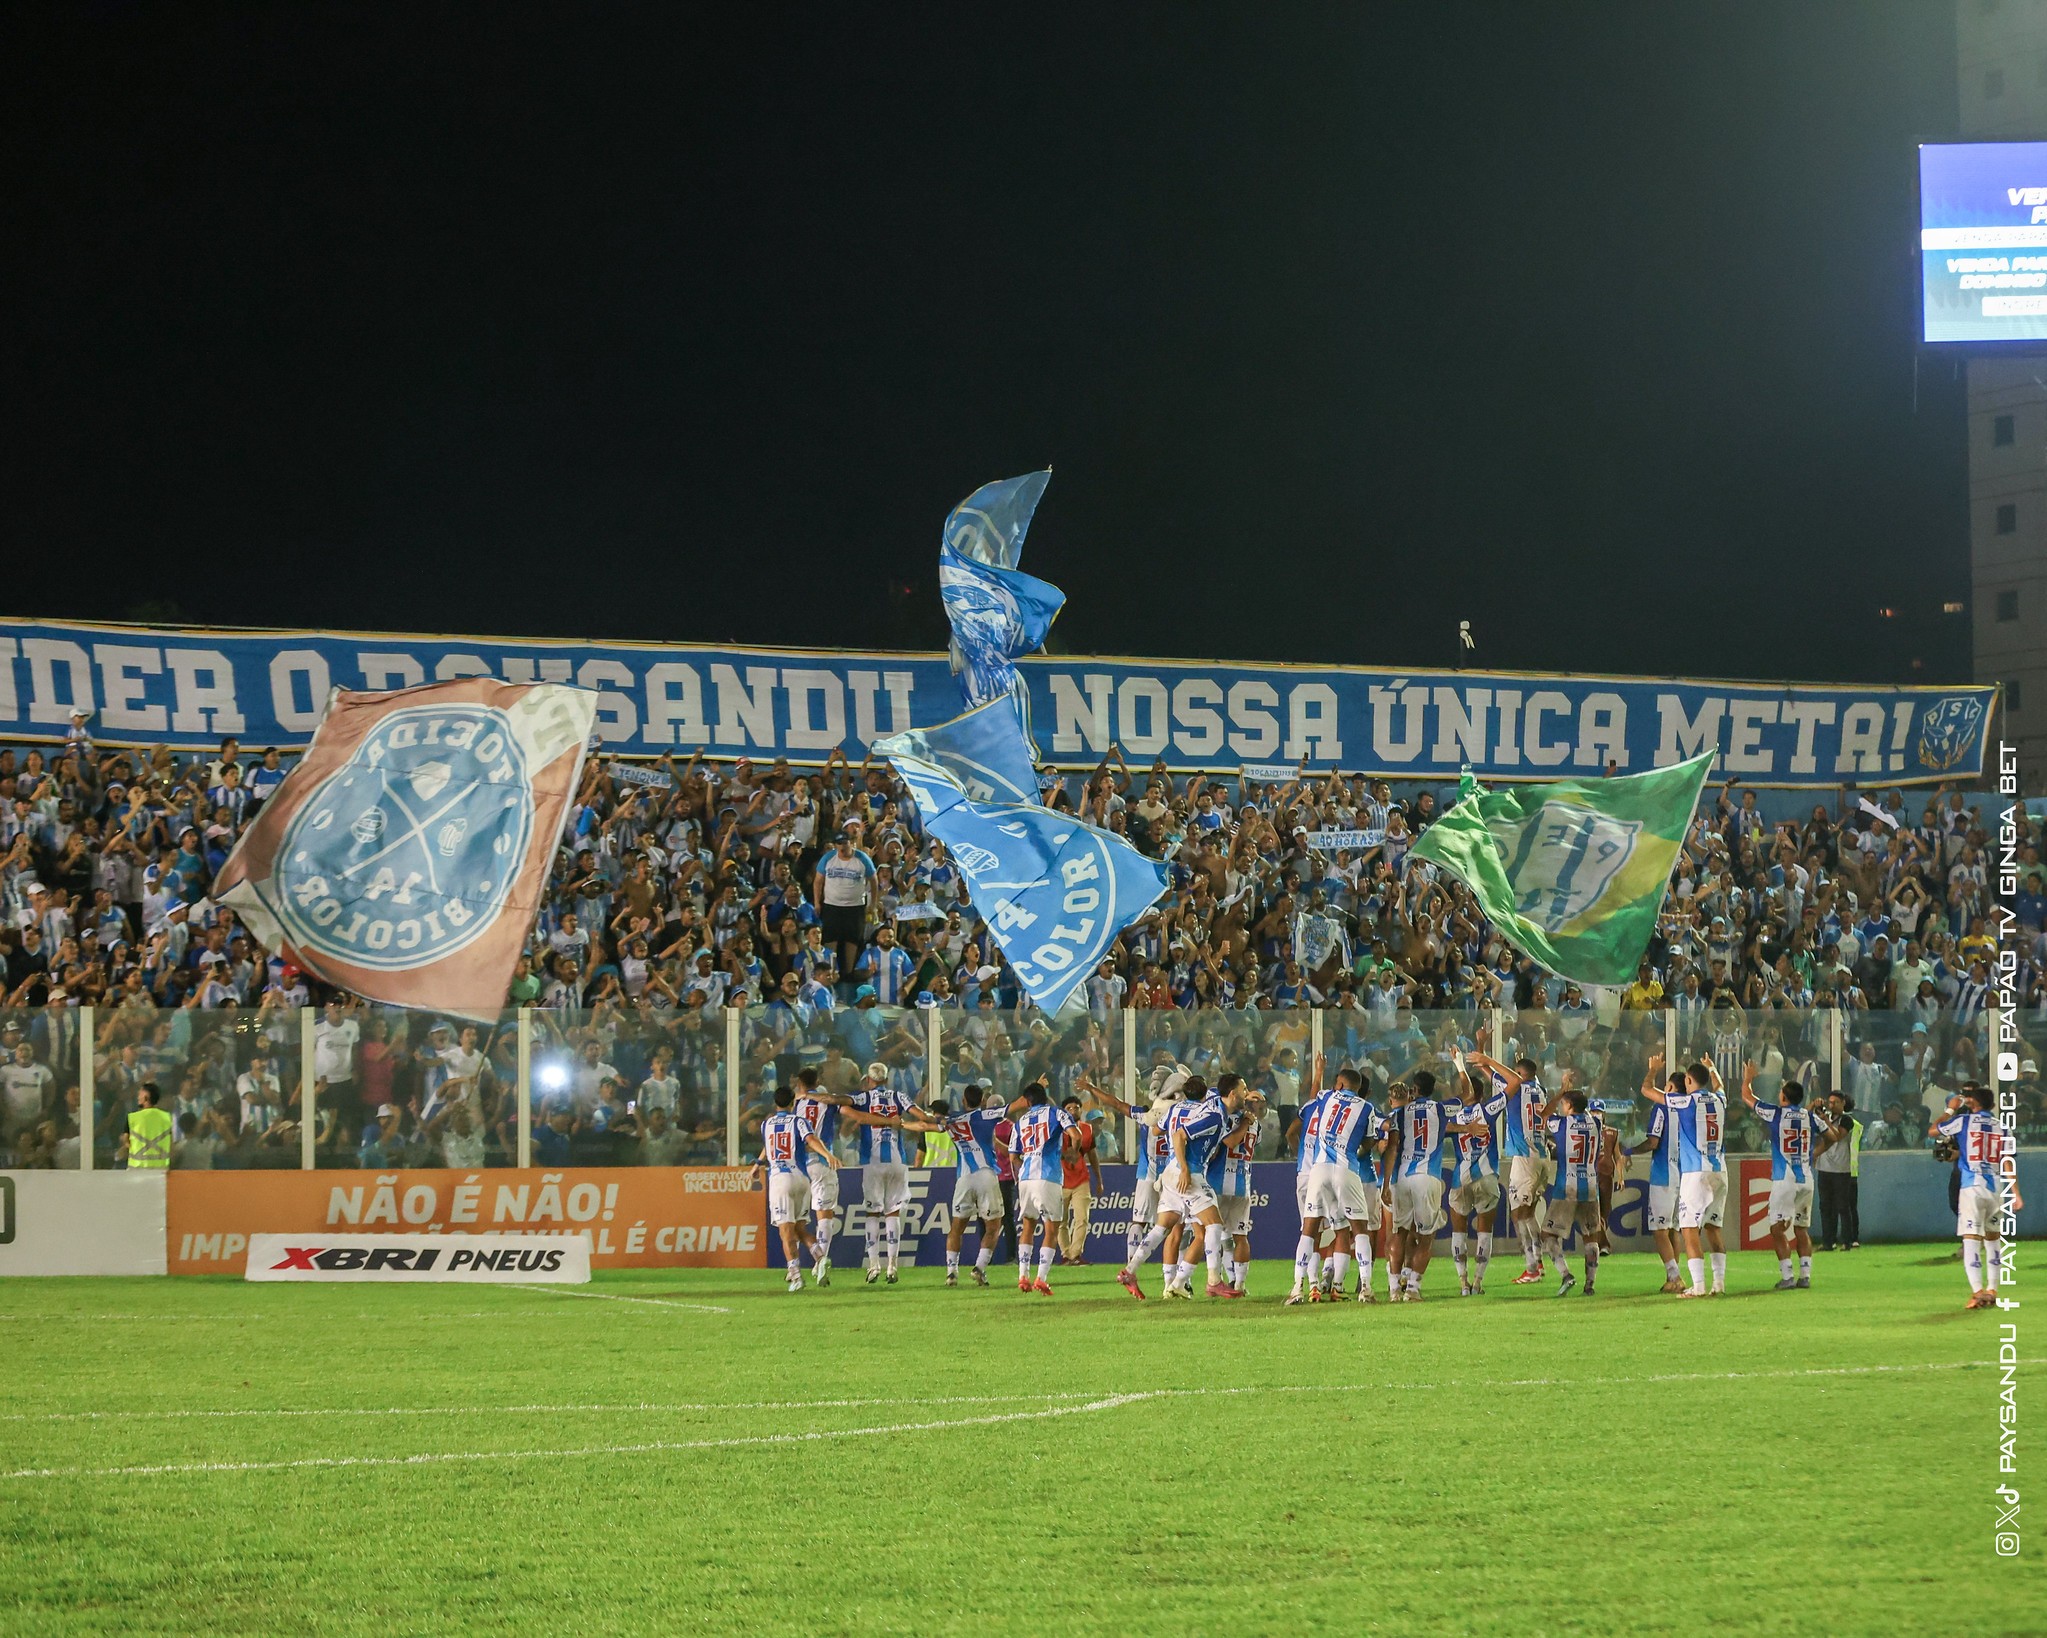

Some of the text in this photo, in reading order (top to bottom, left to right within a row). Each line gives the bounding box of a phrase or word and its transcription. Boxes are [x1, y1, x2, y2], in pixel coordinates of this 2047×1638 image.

[0, 637, 246, 734] DER
[269, 650, 331, 733] O
[1049, 674, 1343, 761] NOSSA
[1369, 678, 1629, 767] ÚNICA
[1653, 694, 1915, 773] META!
[1325, 1103, 1352, 1135] 11
[1706, 1113, 1719, 1142] 6
[767, 1131, 792, 1161] 19
[1568, 1134, 1596, 1164] 31
[1783, 1129, 1810, 1154] 21
[1969, 1131, 2002, 1163] 30
[682, 1169, 750, 1182] OBSERVATÓR
[684, 1180, 752, 1193] INCLUSIV
[326, 1172, 619, 1225] NÃO É NÃO!
[625, 1220, 646, 1254] É
[654, 1225, 758, 1254] CRIME
[269, 1248, 566, 1272] XBRI PNEUS
